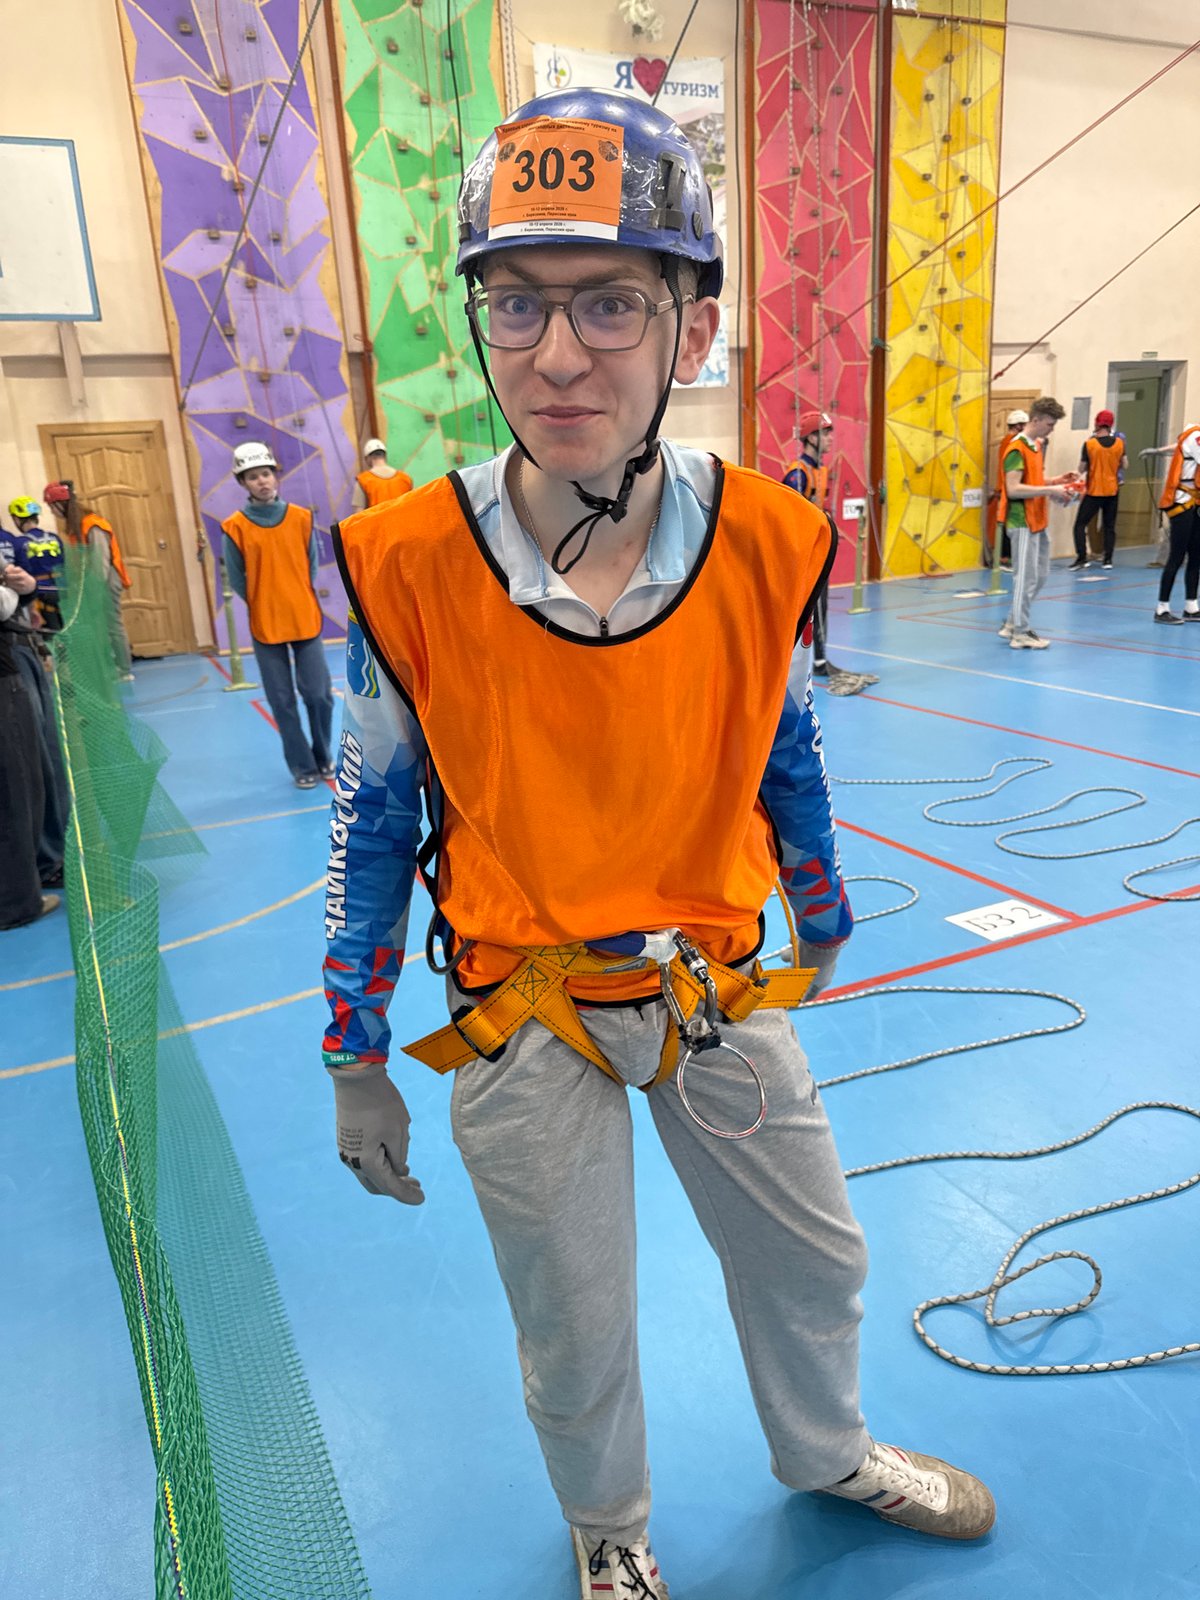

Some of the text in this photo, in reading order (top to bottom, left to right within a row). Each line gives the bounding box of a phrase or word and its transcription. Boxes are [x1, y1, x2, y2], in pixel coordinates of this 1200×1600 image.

[614, 61, 720, 98] Я ТУРИЗМ
[512, 147, 595, 193] 303
[1010, 906, 1042, 919] 2
